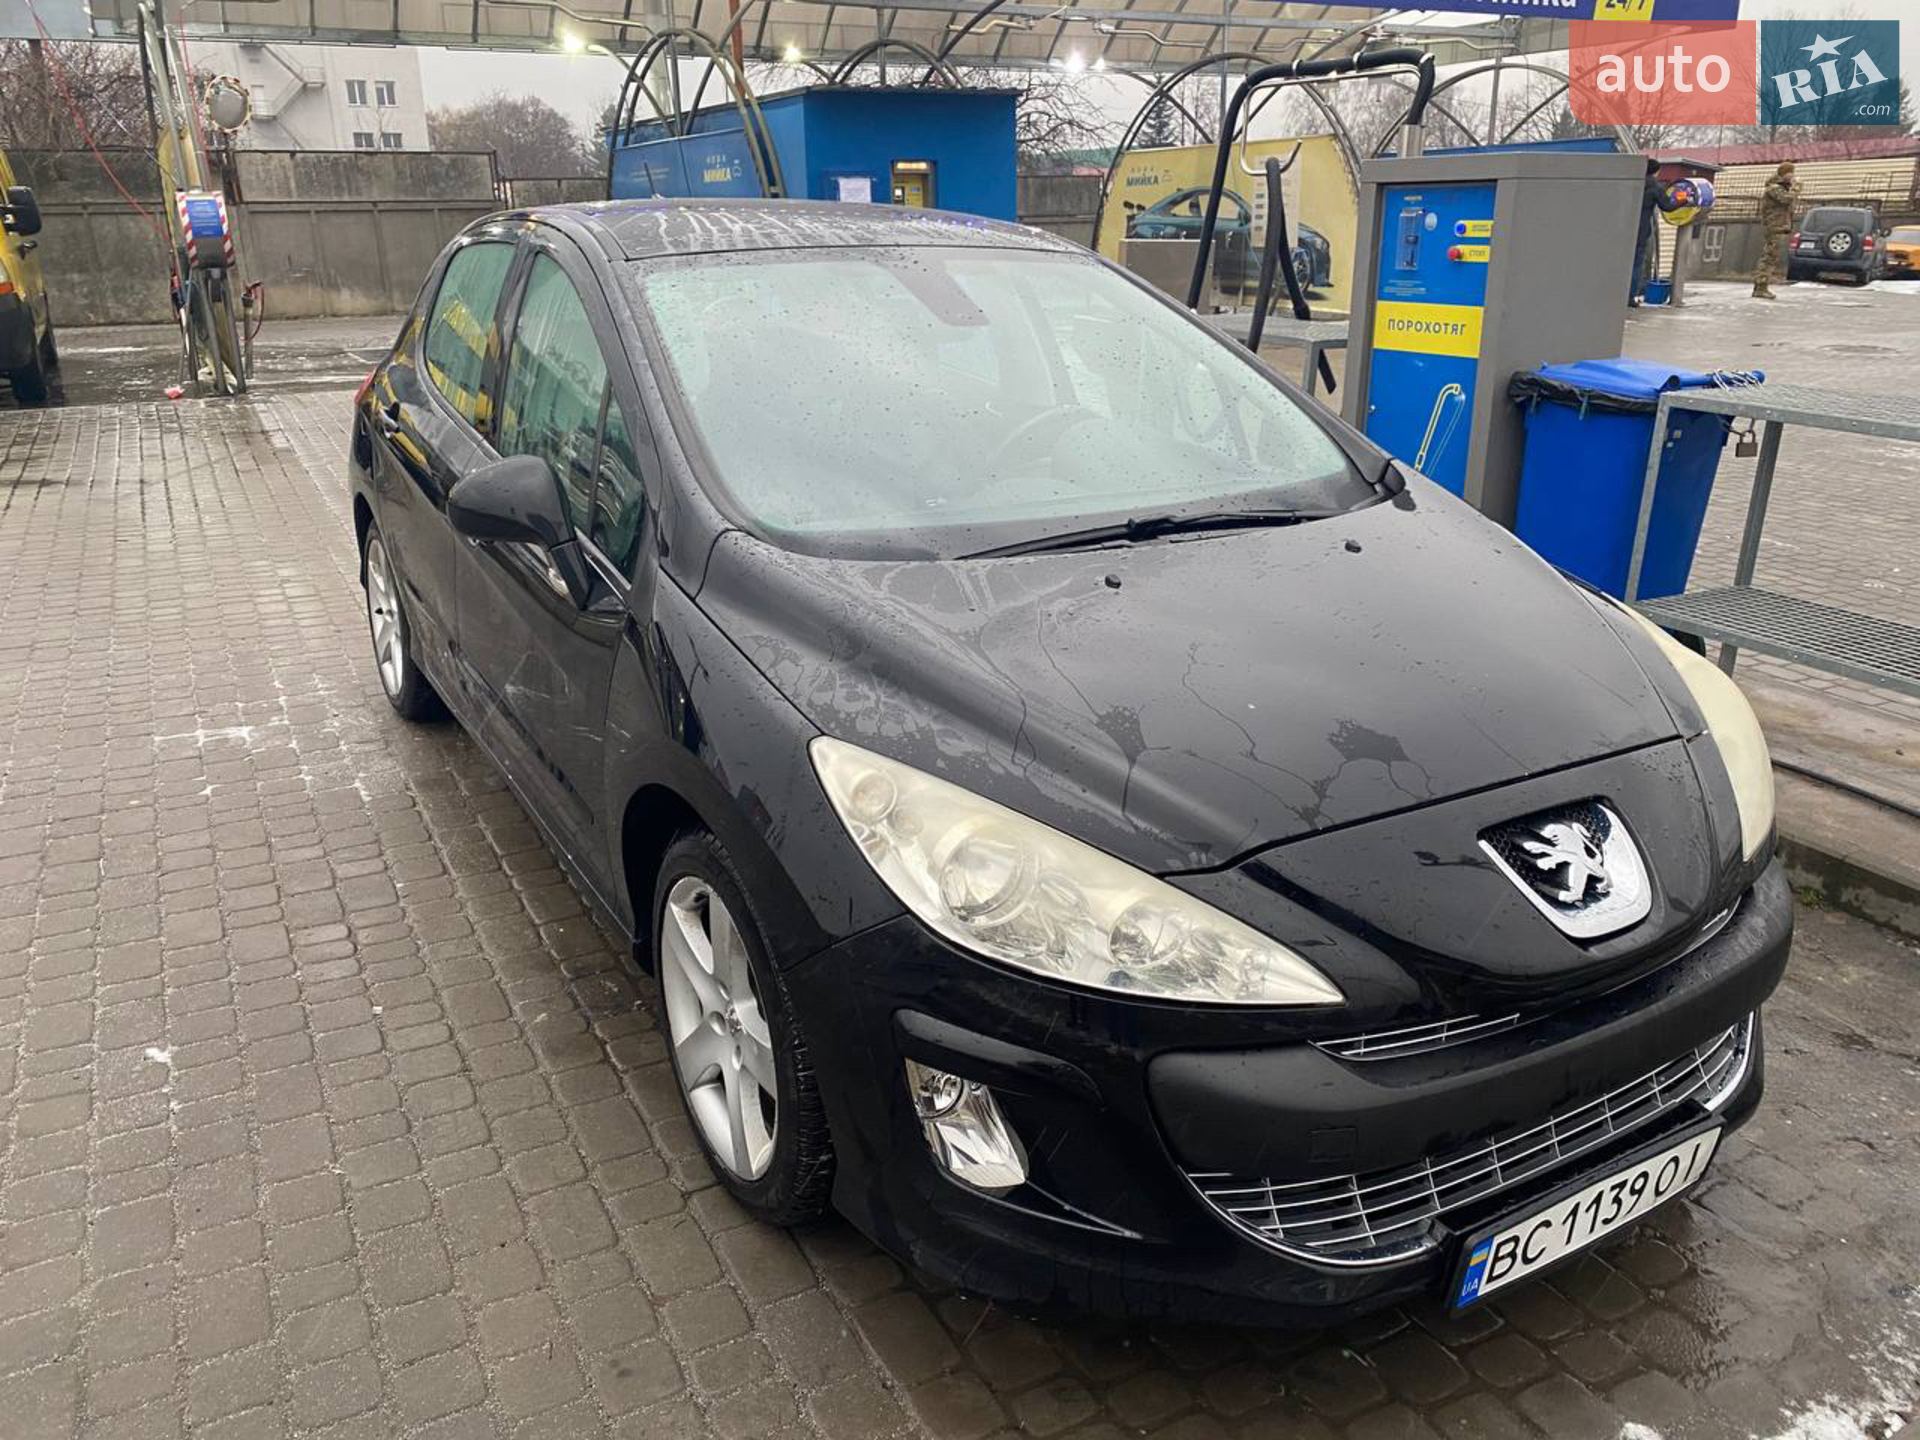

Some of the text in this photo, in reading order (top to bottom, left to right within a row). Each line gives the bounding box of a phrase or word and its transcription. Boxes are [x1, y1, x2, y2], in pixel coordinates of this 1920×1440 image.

[1388, 318, 1467, 336] ПОРОХОТЯГ
[1485, 1219, 1553, 1285] BC
[1562, 1170, 1650, 1247] 1139
[1461, 1277, 1480, 1297] UA
